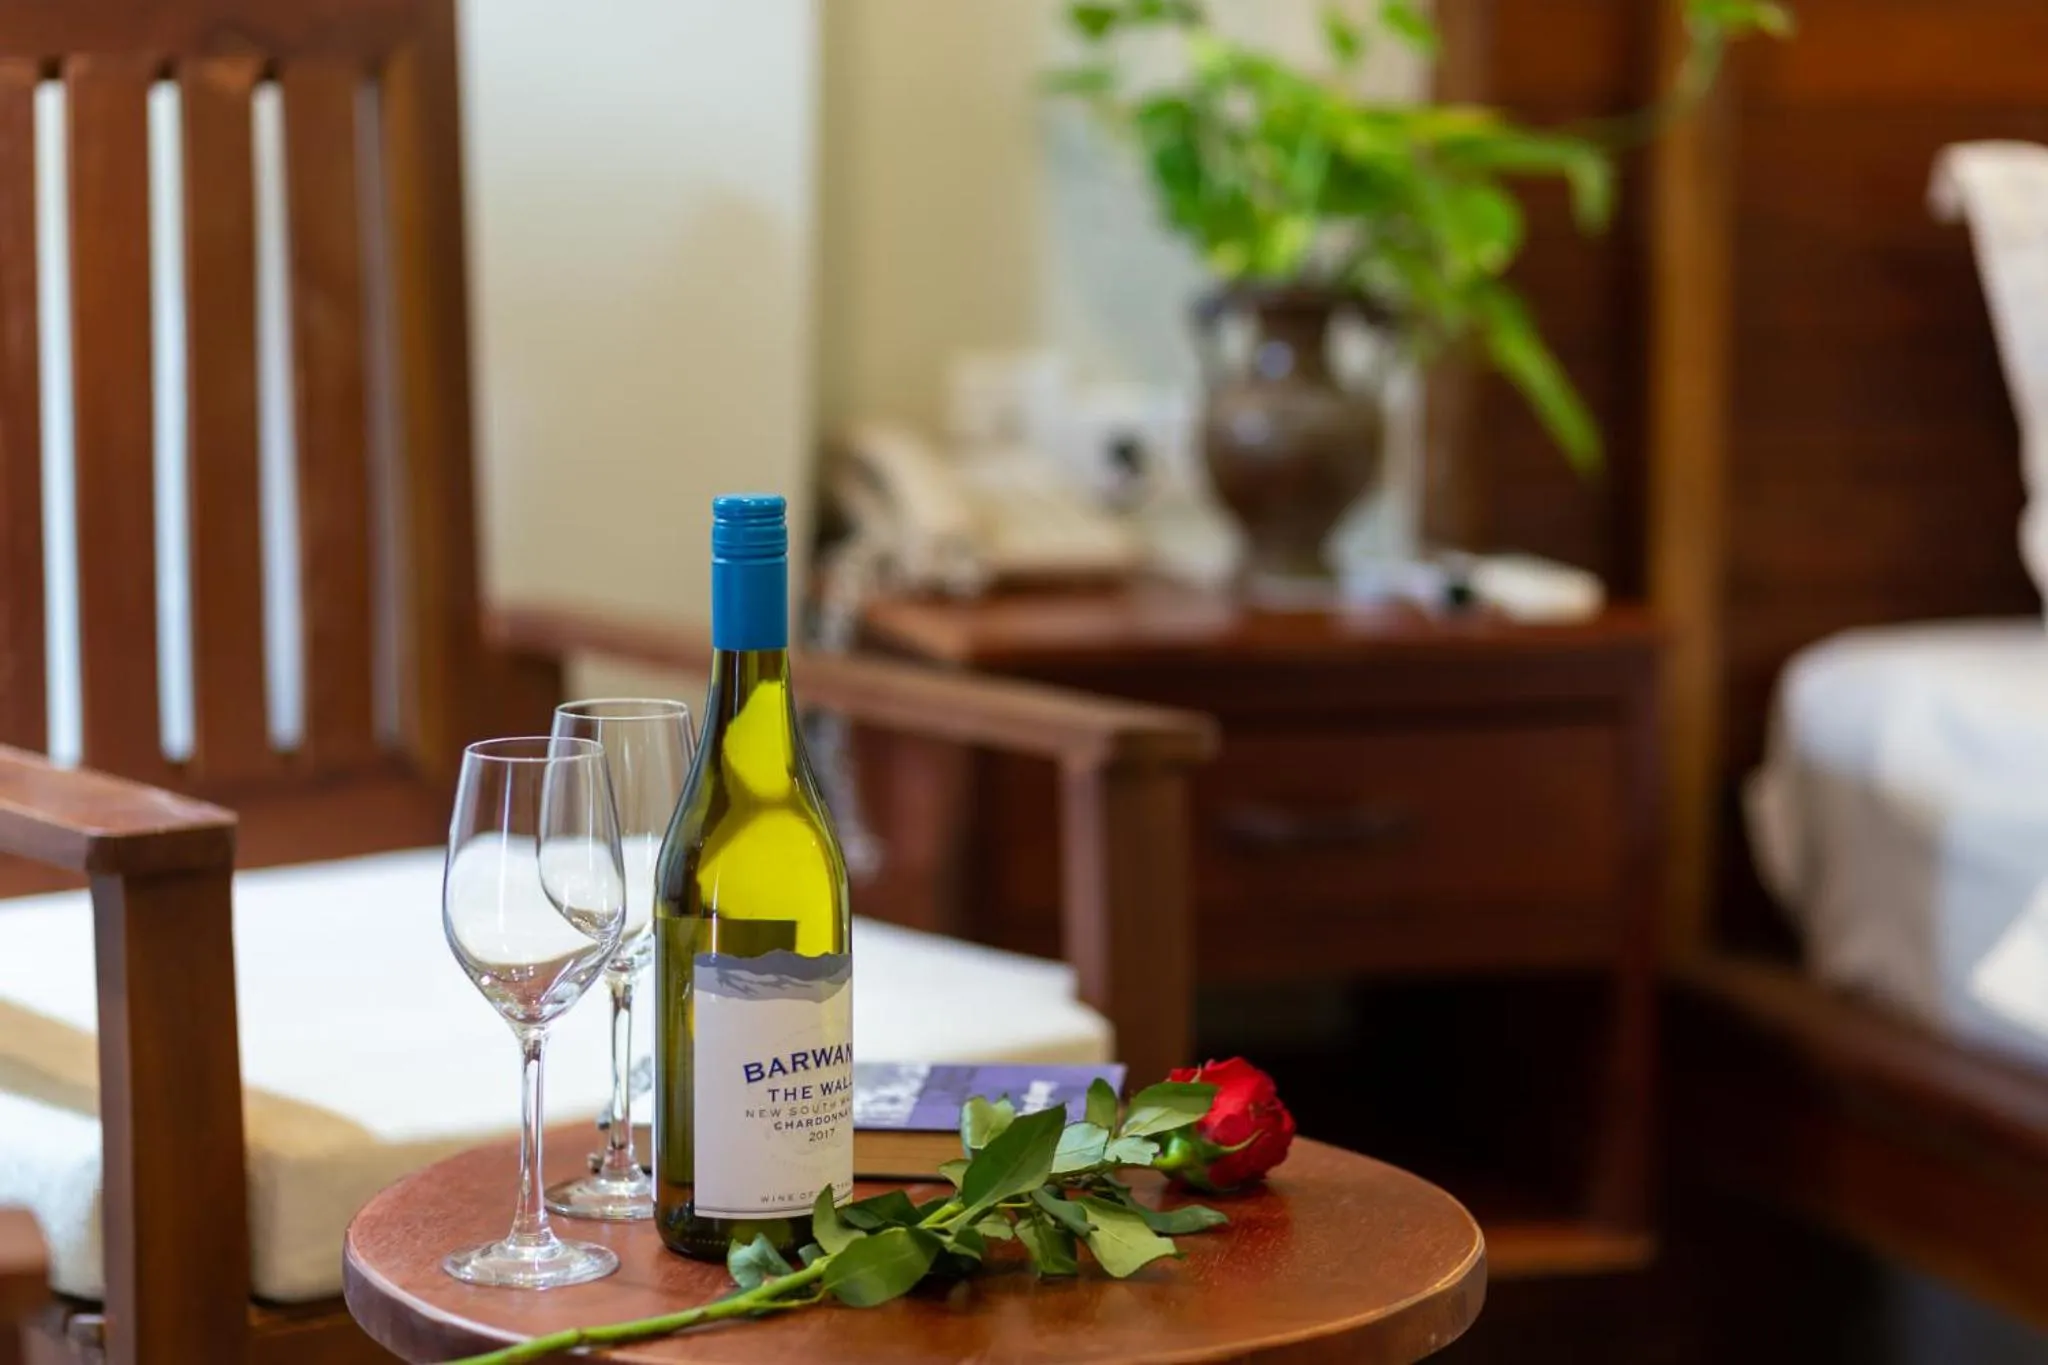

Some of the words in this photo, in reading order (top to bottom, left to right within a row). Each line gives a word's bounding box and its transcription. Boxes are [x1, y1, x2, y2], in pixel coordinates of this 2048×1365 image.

[767, 1085, 813, 1103] THE
[745, 1107, 781, 1119] NEW
[788, 1101, 836, 1117] SOUTH
[774, 1107, 851, 1130] CHARDONNA
[809, 1128, 836, 1142] 2017
[760, 1193, 794, 1206] WINE
